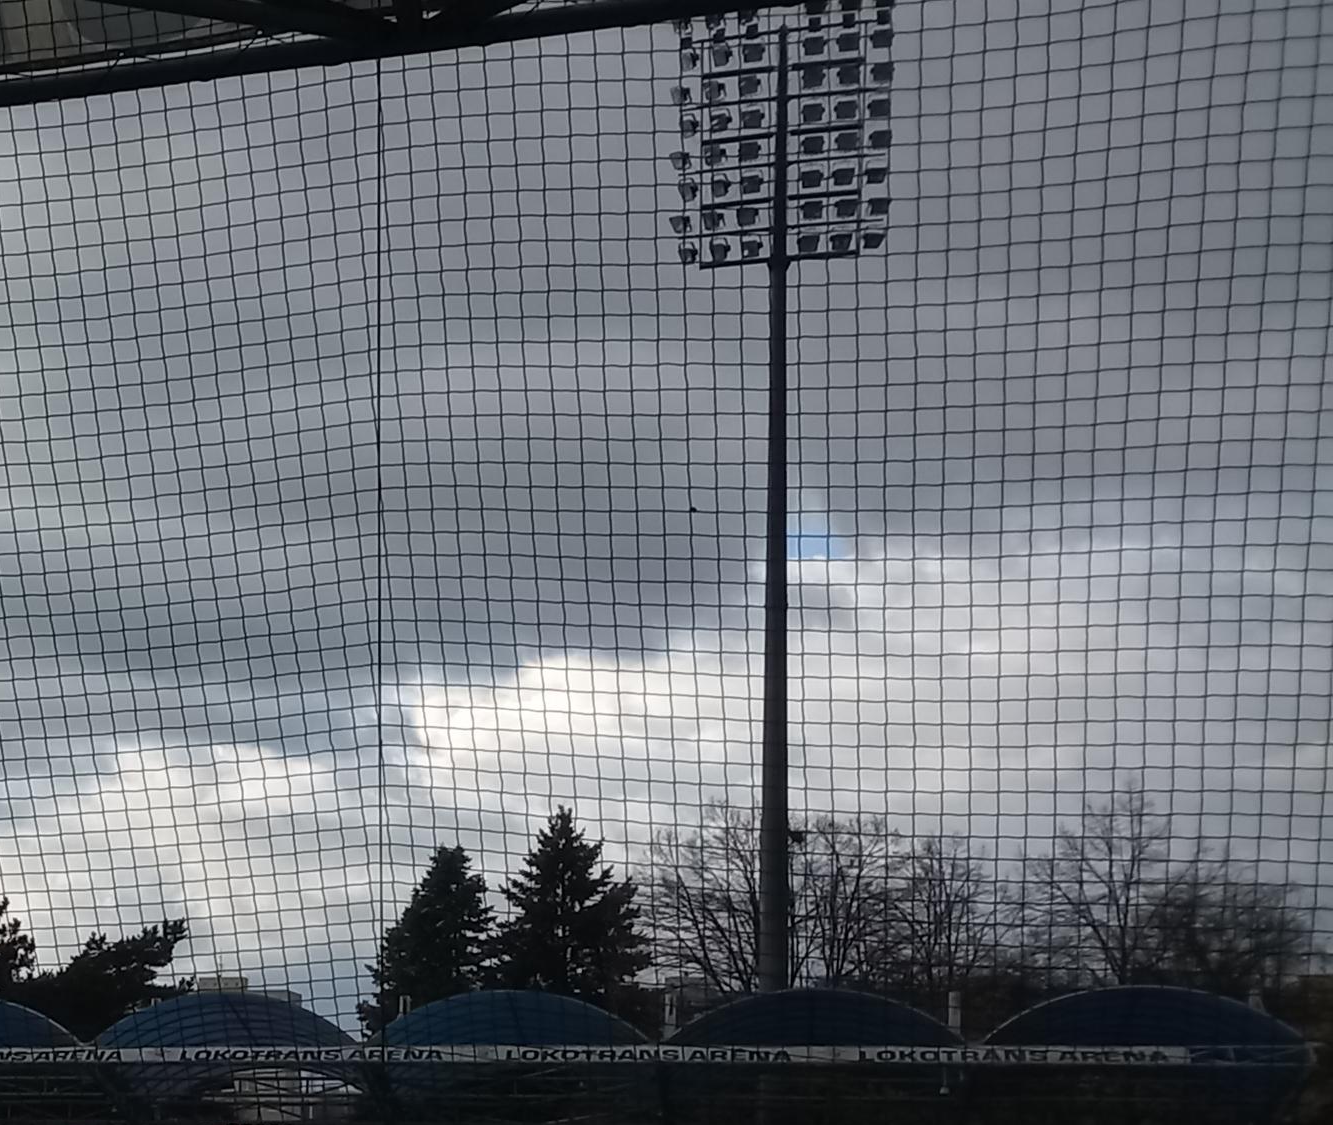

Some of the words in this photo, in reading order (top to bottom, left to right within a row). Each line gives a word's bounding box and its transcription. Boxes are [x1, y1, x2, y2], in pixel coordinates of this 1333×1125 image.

[35, 1051, 121, 1062] ARENA
[180, 1050, 340, 1061] LOKOTRANS
[347, 1050, 443, 1061] ARENA
[505, 1049, 686, 1061] LOKOTRANS
[689, 1049, 793, 1061] ARENA
[859, 1049, 1048, 1062] LOKOTRANS
[1058, 1049, 1170, 1062] ARENA
